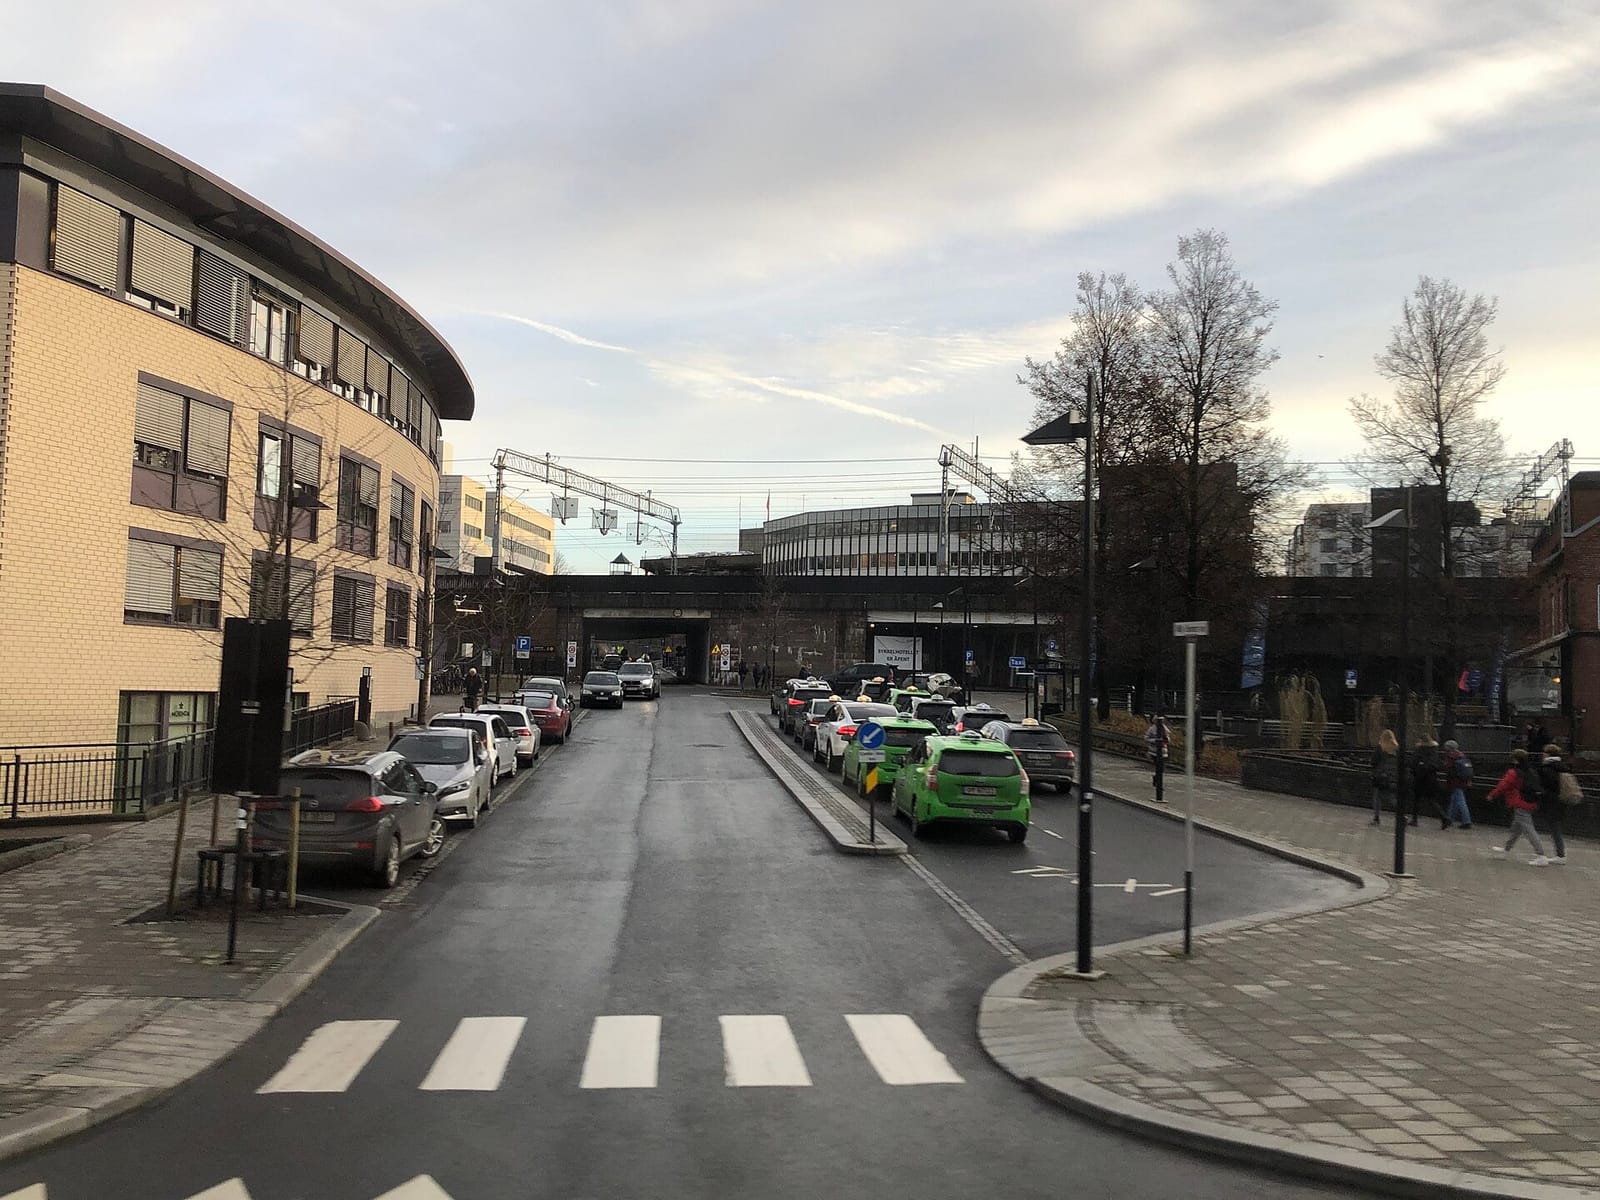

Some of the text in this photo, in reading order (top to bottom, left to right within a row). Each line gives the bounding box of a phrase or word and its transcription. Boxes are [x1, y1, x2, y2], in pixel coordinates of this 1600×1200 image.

[519, 638, 528, 649] P
[966, 652, 972, 660] P
[1010, 658, 1025, 666] Taxi
